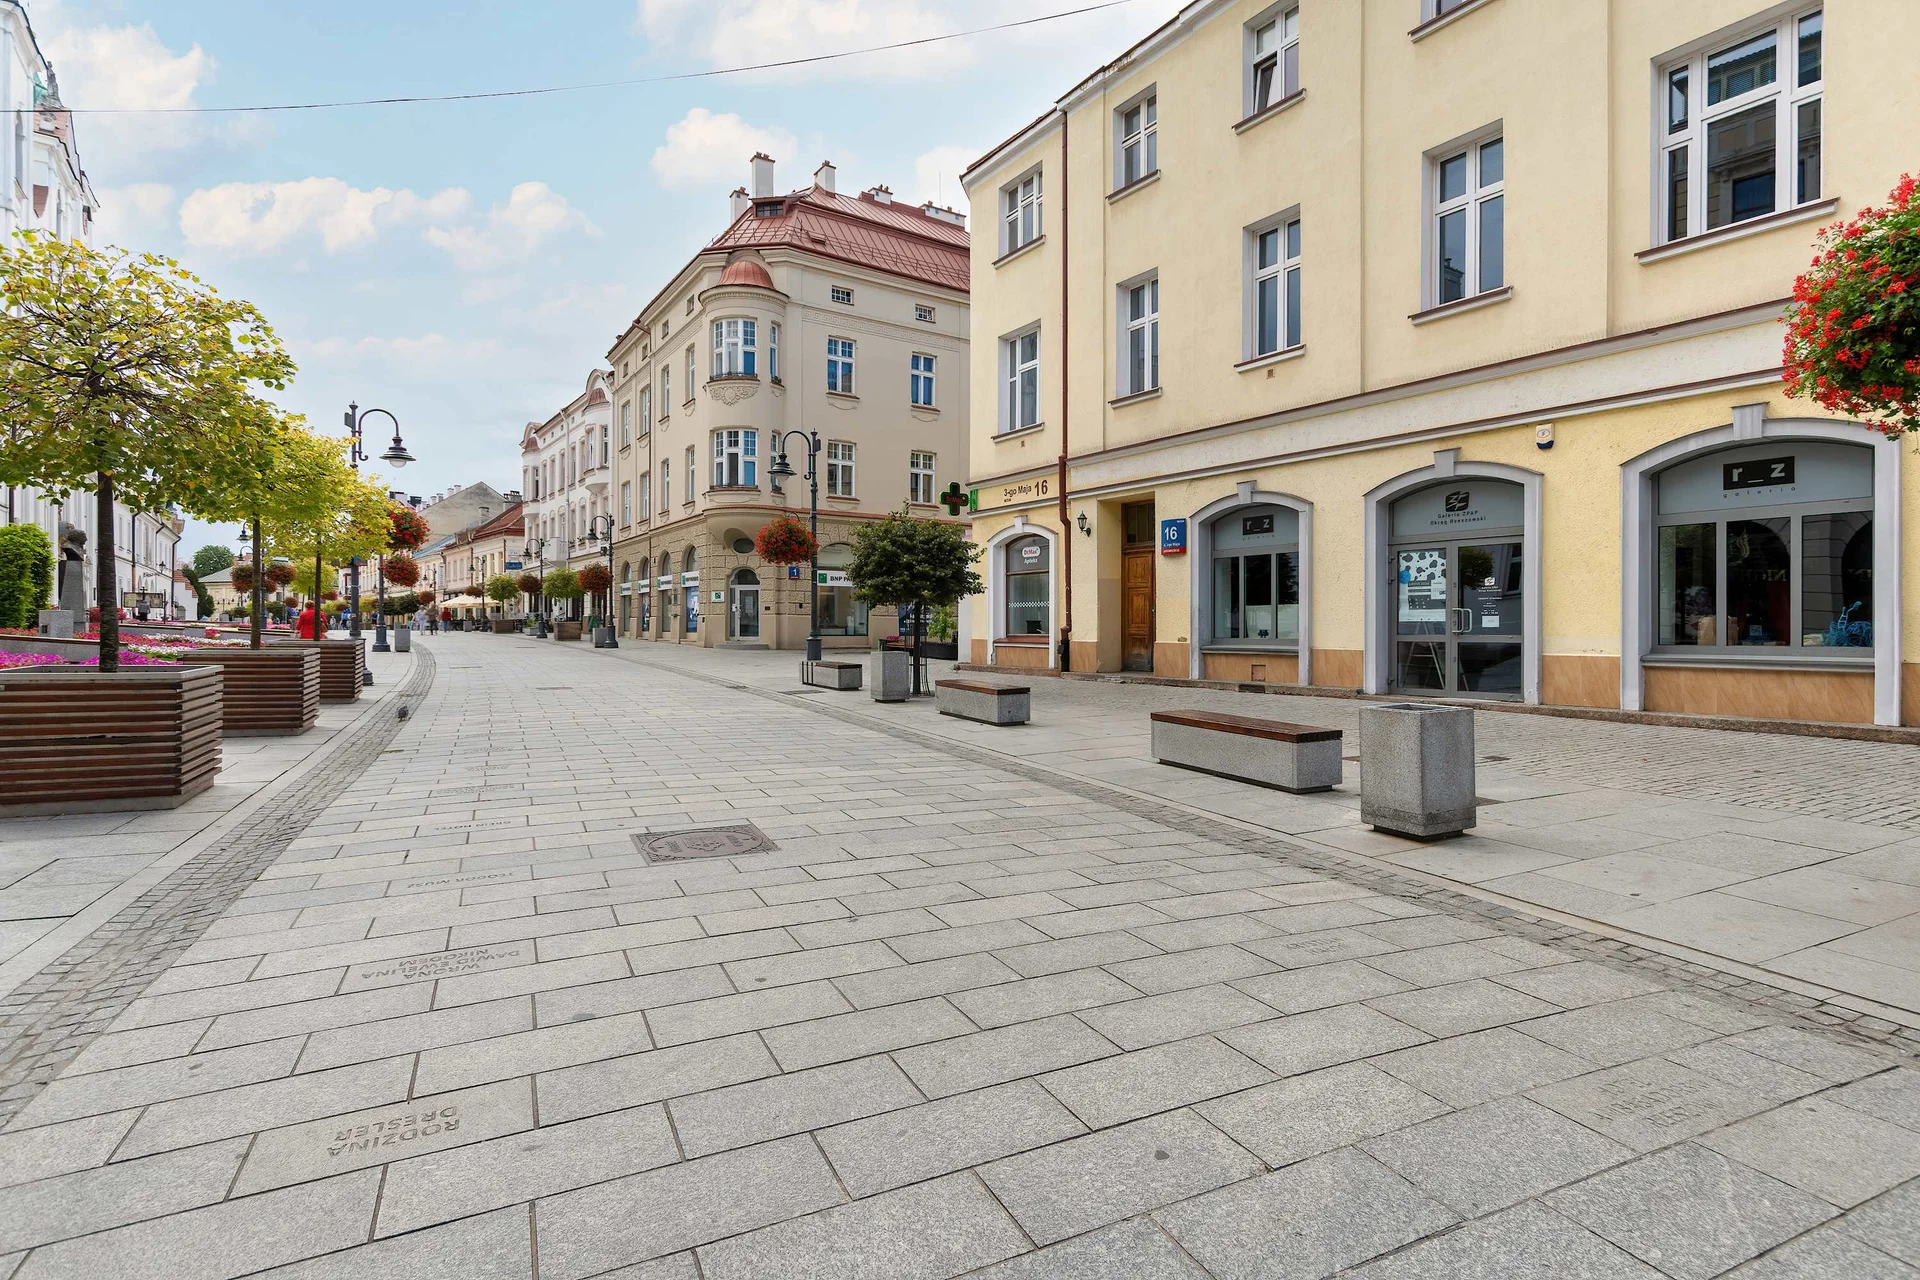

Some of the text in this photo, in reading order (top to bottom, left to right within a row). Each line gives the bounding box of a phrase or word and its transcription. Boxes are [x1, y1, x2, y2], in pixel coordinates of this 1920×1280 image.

[1003, 479, 1048, 497] 3-go Maja 16
[1462, 509, 1478, 517] ZPAP
[1164, 526, 1177, 540] 16
[793, 568, 797, 577] 1
[362, 951, 519, 979] DAWID EWELINA
[399, 950, 488, 966] NIKODEM
[404, 963, 479, 979] WRONA
[334, 1105, 458, 1142] DRESLER
[326, 1118, 461, 1157] RODZINA
